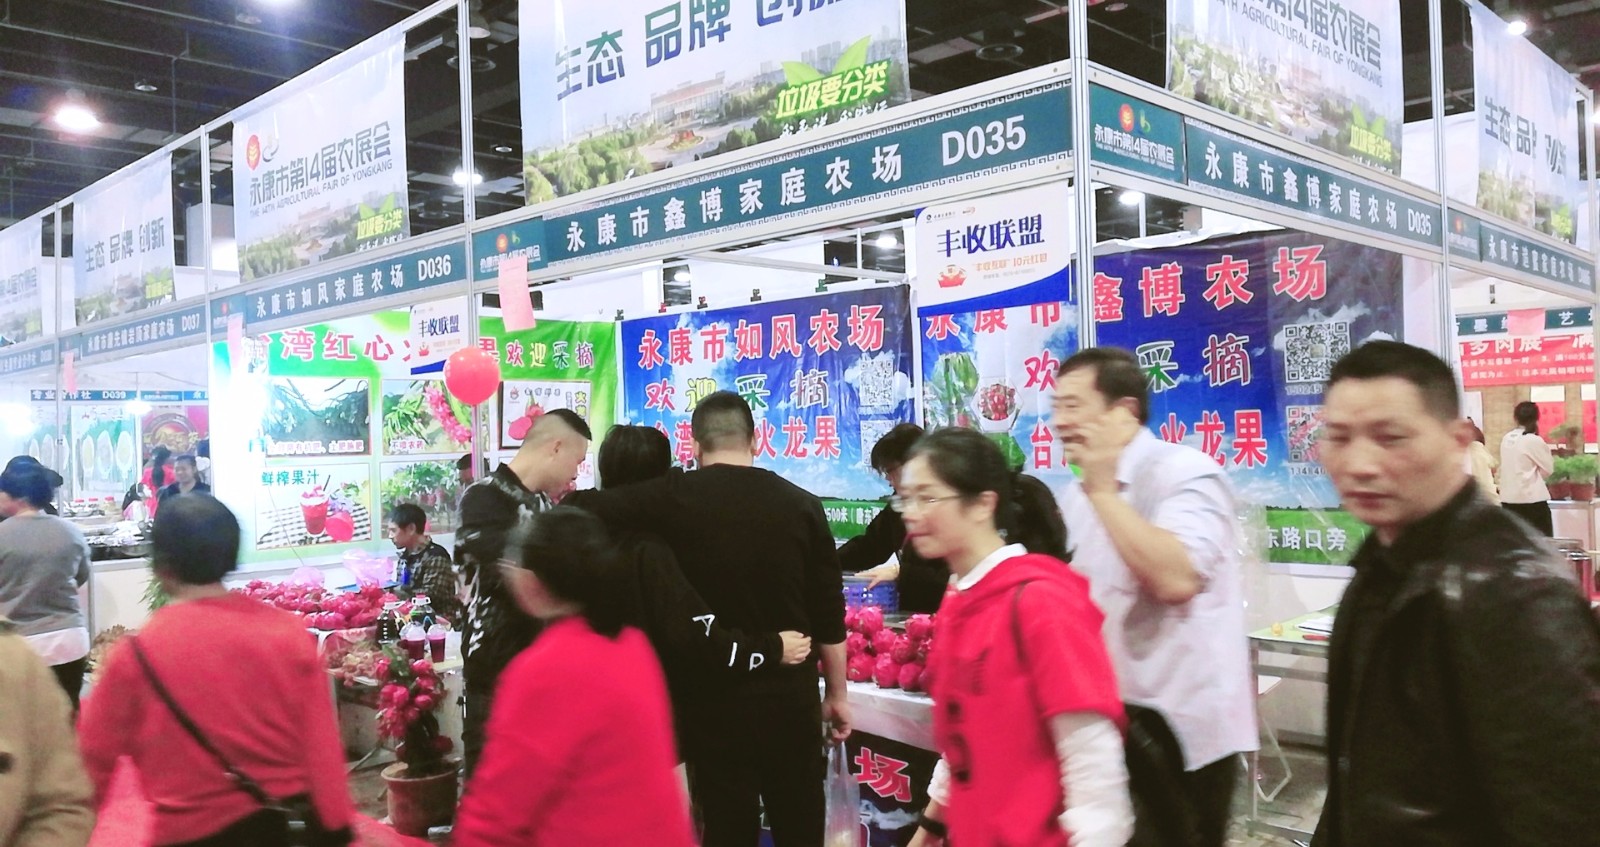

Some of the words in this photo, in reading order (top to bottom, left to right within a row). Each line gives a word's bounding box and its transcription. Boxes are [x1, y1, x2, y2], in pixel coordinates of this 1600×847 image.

[554, 29, 626, 101] 生态
[644, 0, 732, 68] 品牌
[1311, 40, 1331, 58] FAIR
[775, 61, 888, 120] 垃圾要分类
[249, 121, 391, 206] 永康市第14届农展会
[322, 179, 339, 192] FAIR
[340, 176, 350, 187] OF
[352, 159, 393, 182] YONGKANG
[566, 143, 902, 252] 永康市鑫博家庭农场
[940, 114, 1027, 167] D035
[1204, 141, 1398, 231] 永康市鑫博家庭农场
[1407, 208, 1432, 237] D035
[937, 214, 1045, 257] 丰收联盟
[256, 263, 404, 318] 永康市如风家庭农场
[417, 254, 452, 281] D036
[181, 313, 200, 332] D037
[419, 314, 460, 338] 丰收联盟
[638, 305, 885, 370] 永康市如风农场
[102, 390, 127, 399] D039
[654, 415, 841, 460] 湾火龙果
[261, 469, 319, 486] 鲜榨果汁
[854, 747, 912, 802] 场
